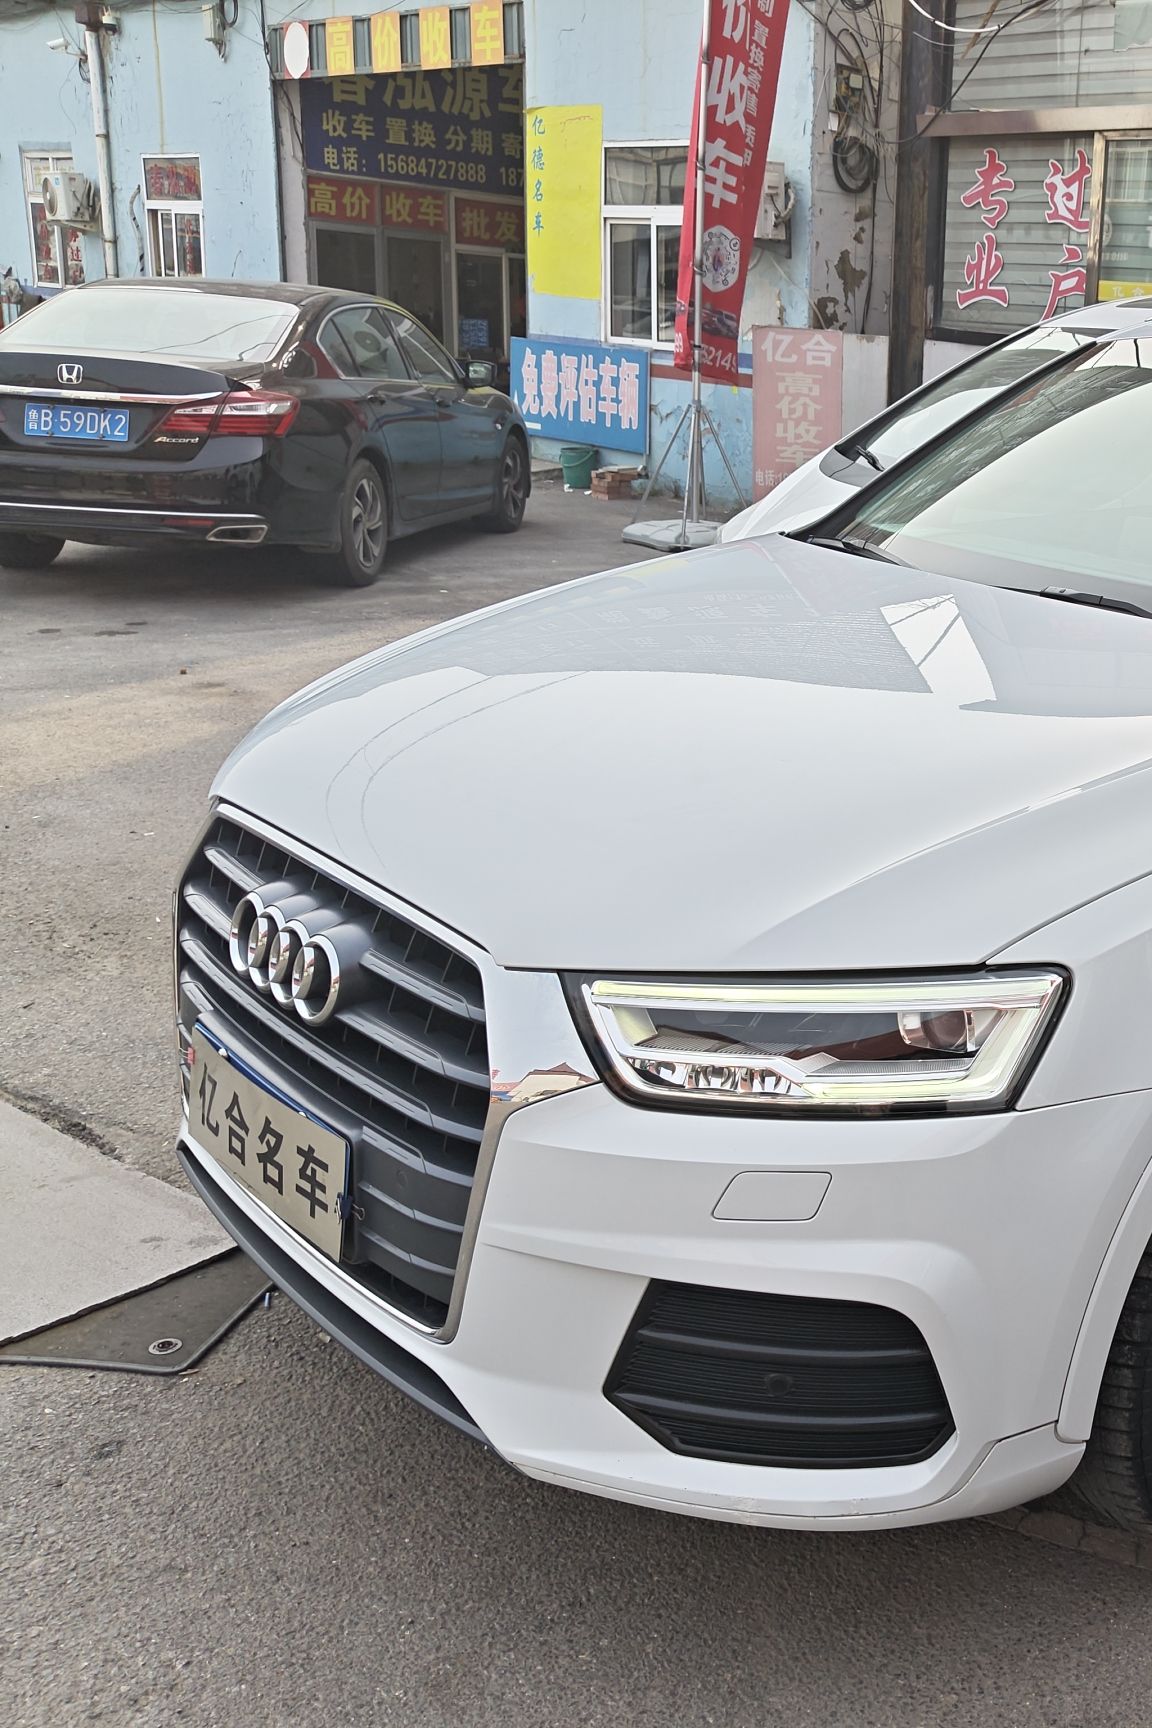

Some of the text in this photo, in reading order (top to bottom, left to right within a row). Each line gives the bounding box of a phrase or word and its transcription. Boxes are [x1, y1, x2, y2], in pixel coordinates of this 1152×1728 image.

[328, 6, 500, 72] 高价收车
[322, 109, 375, 141] 收车
[385, 117, 436, 148] 置换
[445, 125, 493, 156] 分期
[378, 152, 486, 184] 15684727888
[308, 182, 519, 243] 高价 收车 批发
[956, 147, 1015, 309] 专业
[1040, 147, 1093, 322] 过户
[761, 331, 838, 367] 亿合
[522, 347, 639, 430] 免费评估车辆
[153, 436, 200, 444] Accord
[198, 1061, 329, 1219] 亿合名车
